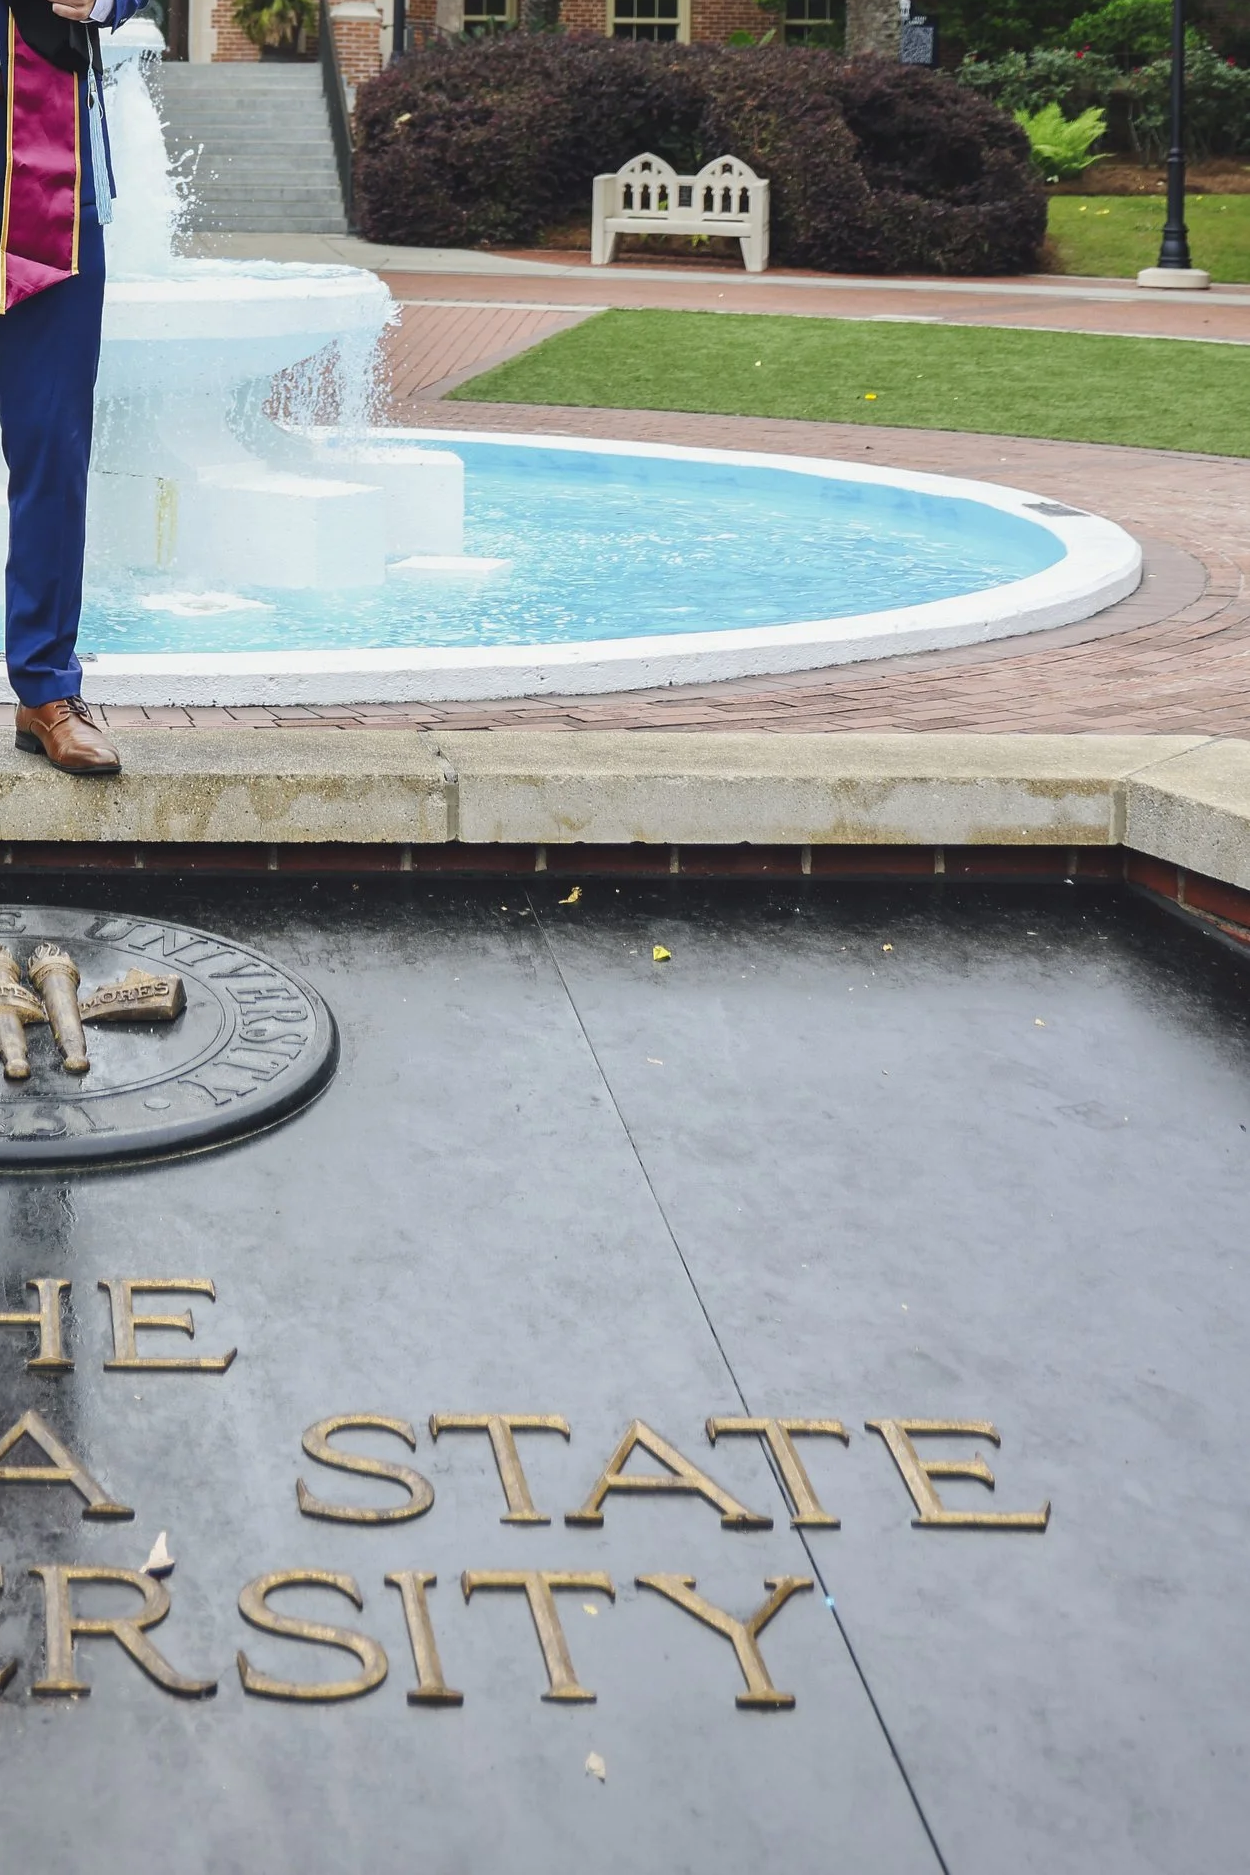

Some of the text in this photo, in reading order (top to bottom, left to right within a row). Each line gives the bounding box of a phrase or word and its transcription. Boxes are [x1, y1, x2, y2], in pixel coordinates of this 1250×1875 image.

[80, 981, 170, 1012] MORES
[83, 916, 310, 1107] UNIVERSITY
[295, 1410, 1053, 1532] STATE
